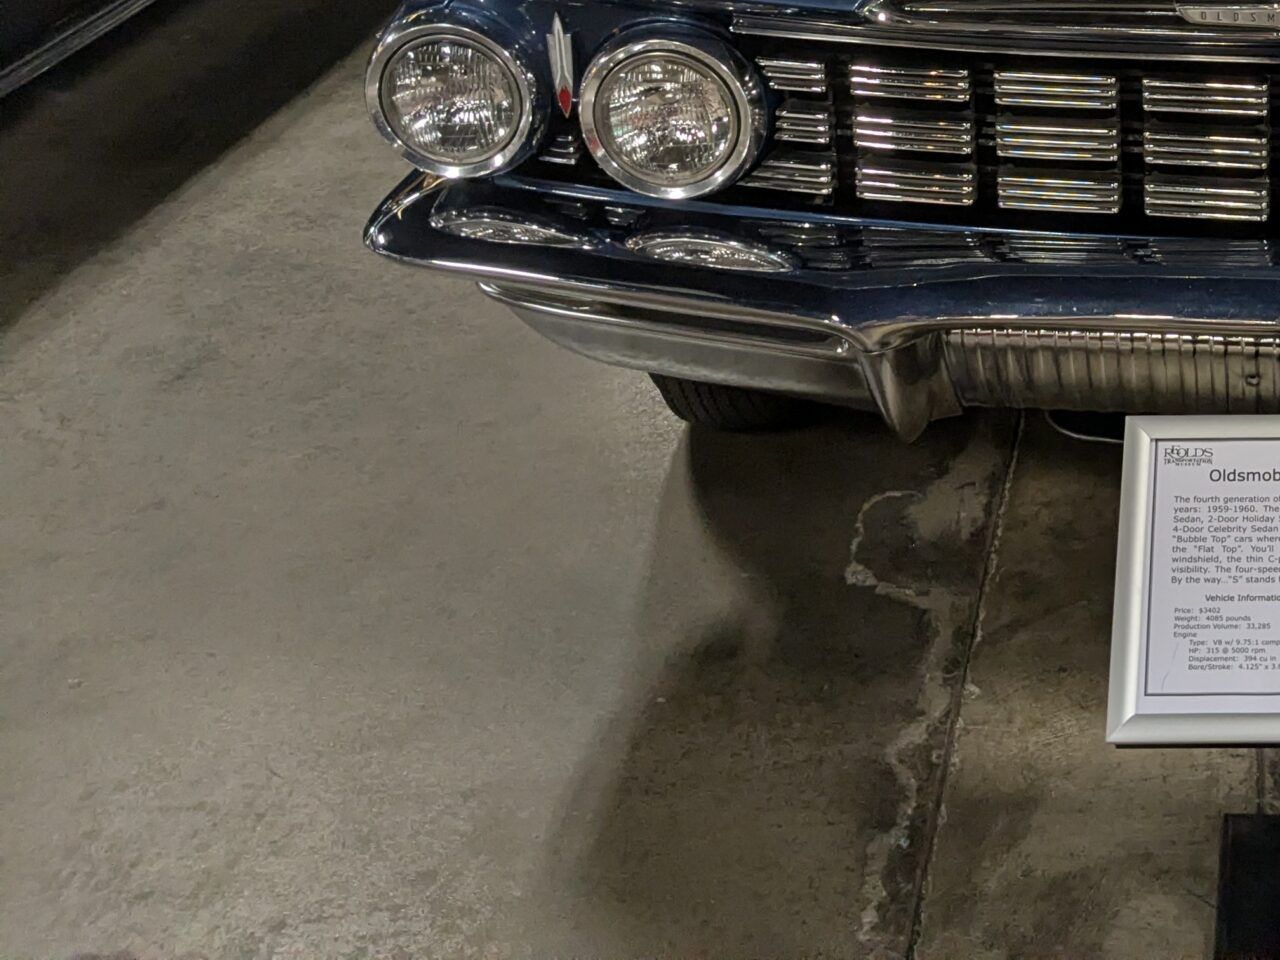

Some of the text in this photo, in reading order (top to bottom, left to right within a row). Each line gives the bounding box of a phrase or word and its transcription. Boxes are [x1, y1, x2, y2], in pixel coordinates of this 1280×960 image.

[1223, 495, 1270, 504] generation
[1173, 515, 1204, 524] Sedan,
[1242, 515, 1275, 524] Holiday
[1207, 525, 1248, 534] Celebrity
